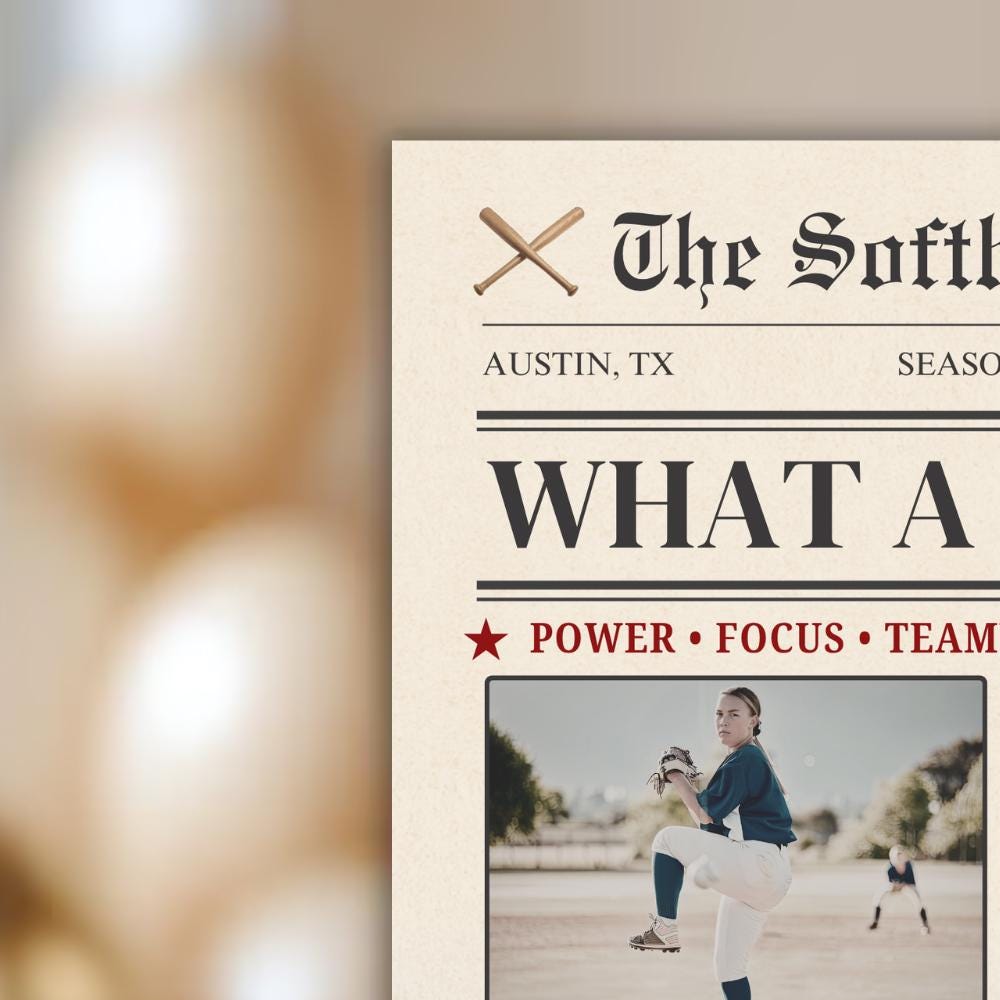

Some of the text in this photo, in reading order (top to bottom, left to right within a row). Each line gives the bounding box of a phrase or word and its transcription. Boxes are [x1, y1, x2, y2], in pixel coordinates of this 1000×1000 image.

[614, 211, 761, 309] The
[482, 352, 675, 380] AUSTIN, TX
[486, 460, 861, 549] WHAT
[892, 460, 975, 549] A
[530, 621, 675, 654] POWER
[716, 621, 844, 654] FOCUS
